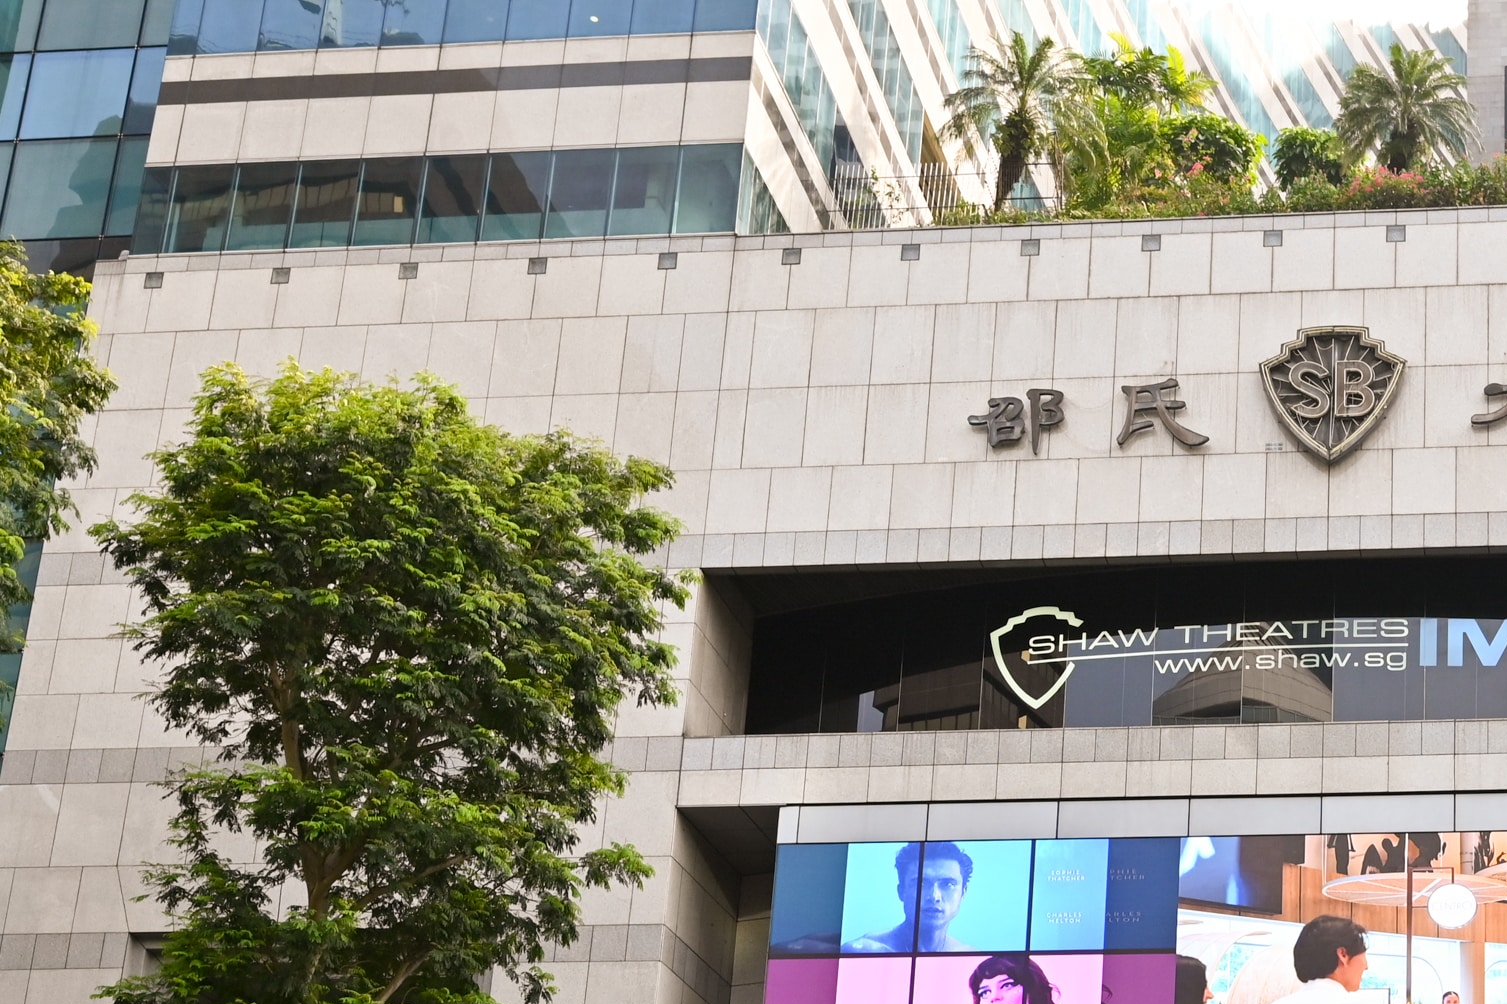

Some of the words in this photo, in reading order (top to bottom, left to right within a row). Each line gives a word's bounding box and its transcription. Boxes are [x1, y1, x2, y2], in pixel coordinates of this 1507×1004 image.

[1288, 360, 1375, 418] SB
[1027, 628, 1159, 655] SHAW
[1174, 619, 1409, 643] THEATRES
[1155, 649, 1407, 673] www.shaw.sg
